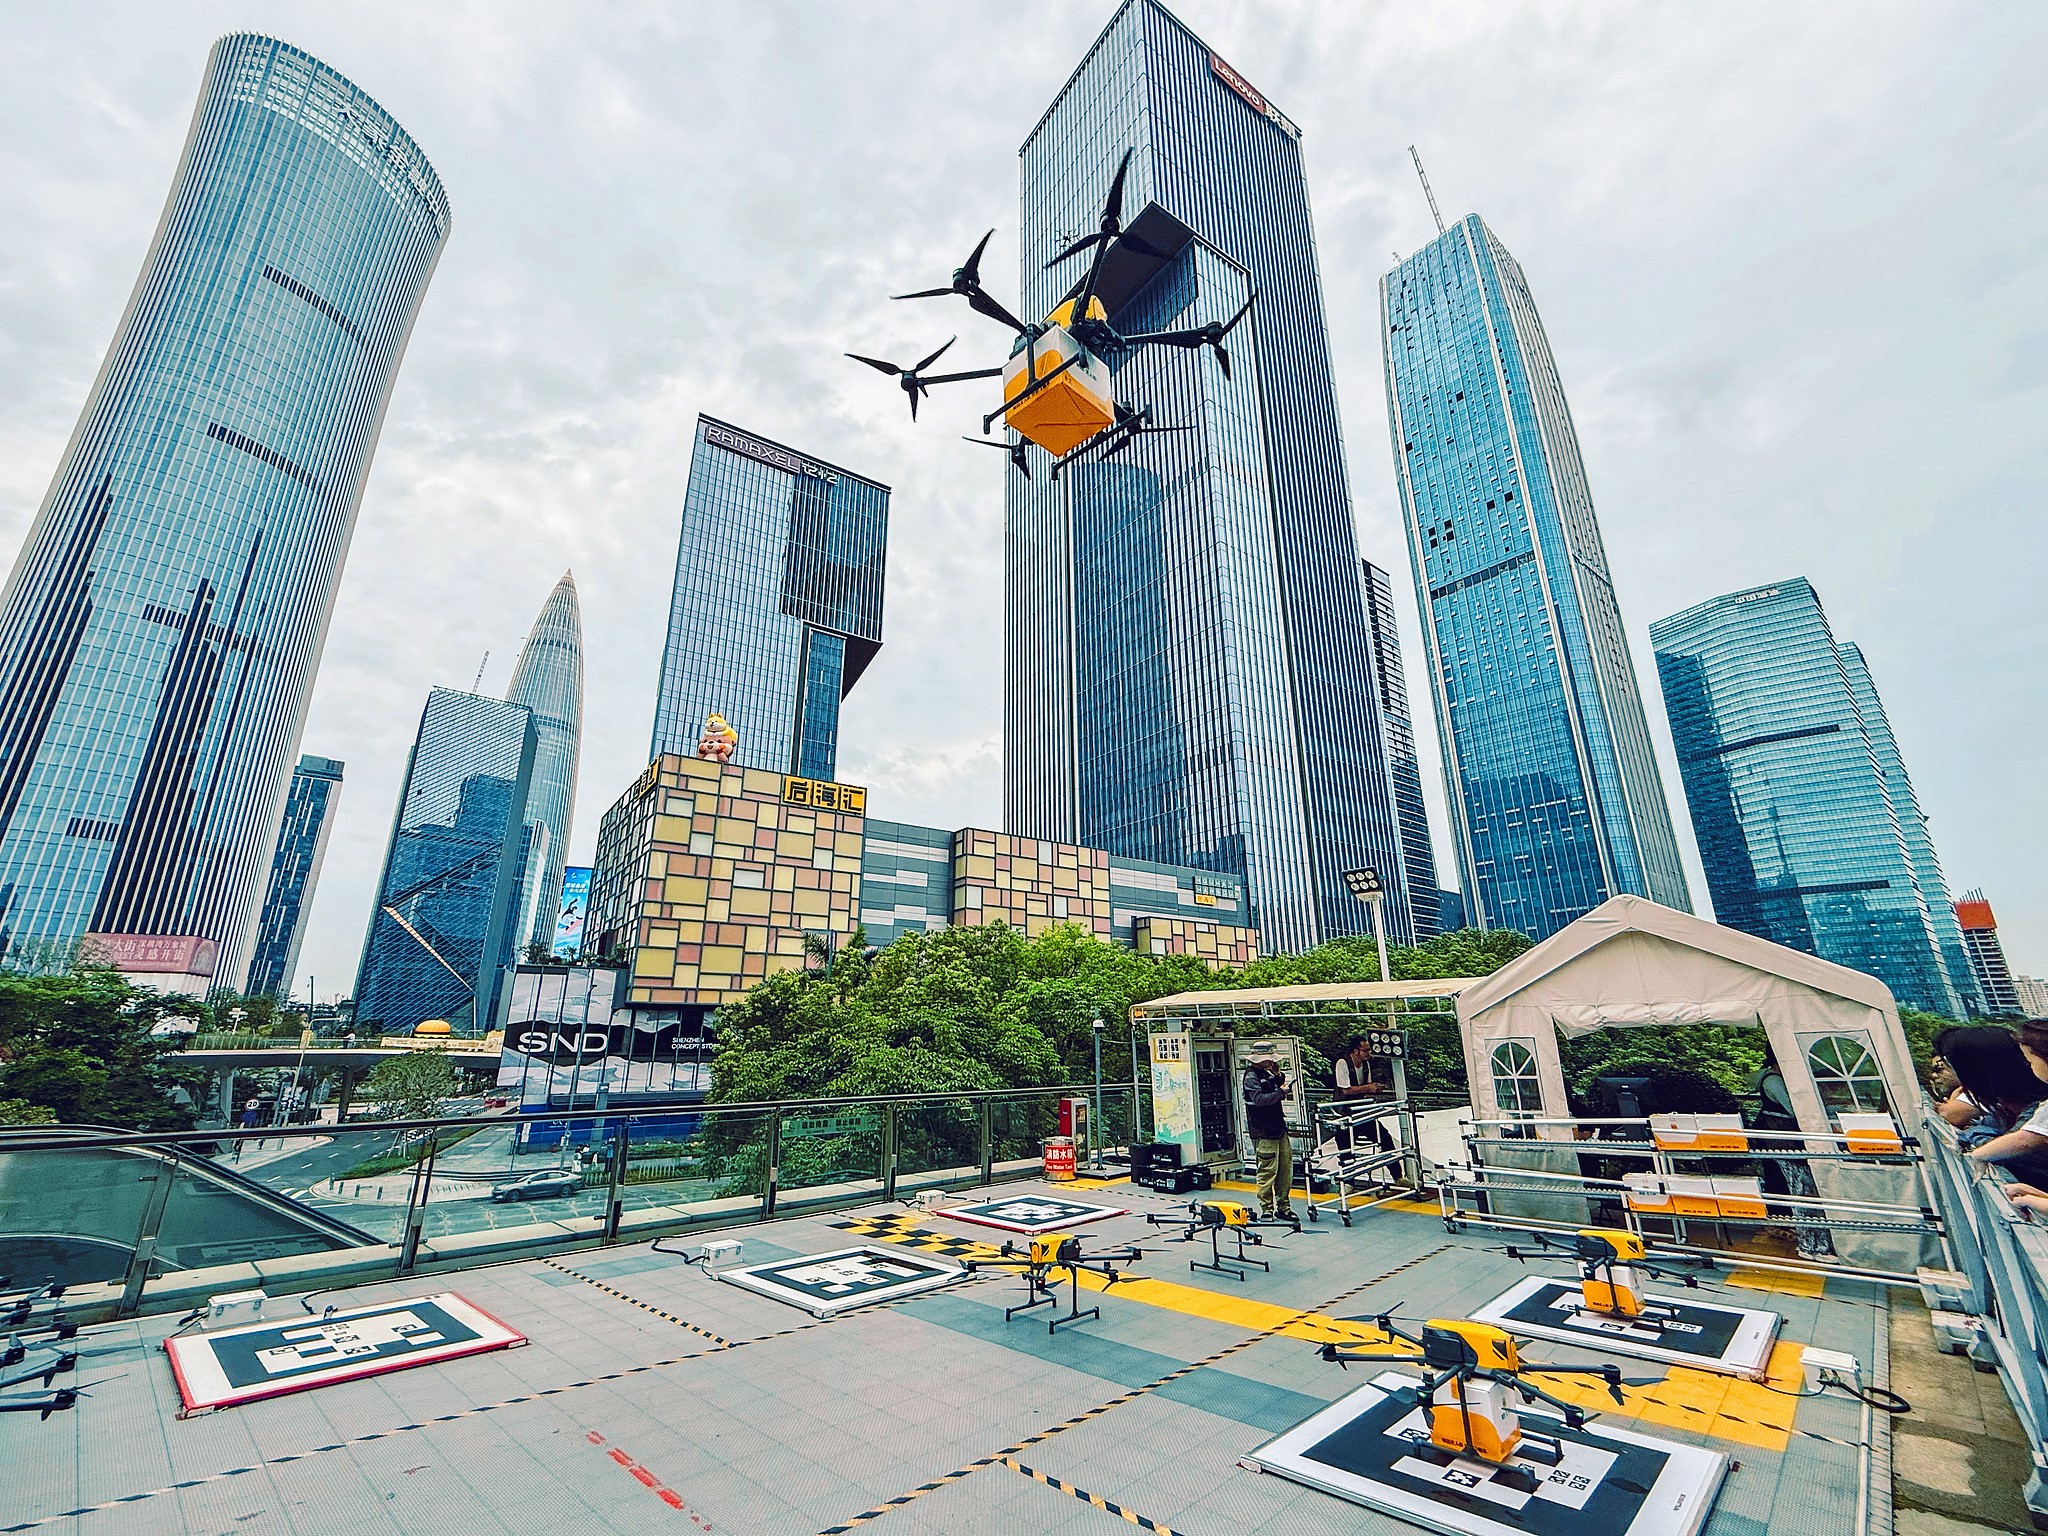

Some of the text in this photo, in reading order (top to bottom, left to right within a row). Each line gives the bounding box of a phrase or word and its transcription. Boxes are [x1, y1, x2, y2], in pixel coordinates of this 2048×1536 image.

[1215, 58, 1260, 106] Lenovo
[332, 102, 446, 236] 大家金融中心
[707, 426, 799, 471] RAMAXEL
[787, 780, 863, 811] 后海汇
[134, 948, 186, 961] 灵感开街
[518, 1032, 608, 1053] SND
[247, 1100, 258, 1108] 20
[1046, 1148, 1073, 1160] 消防水箱
